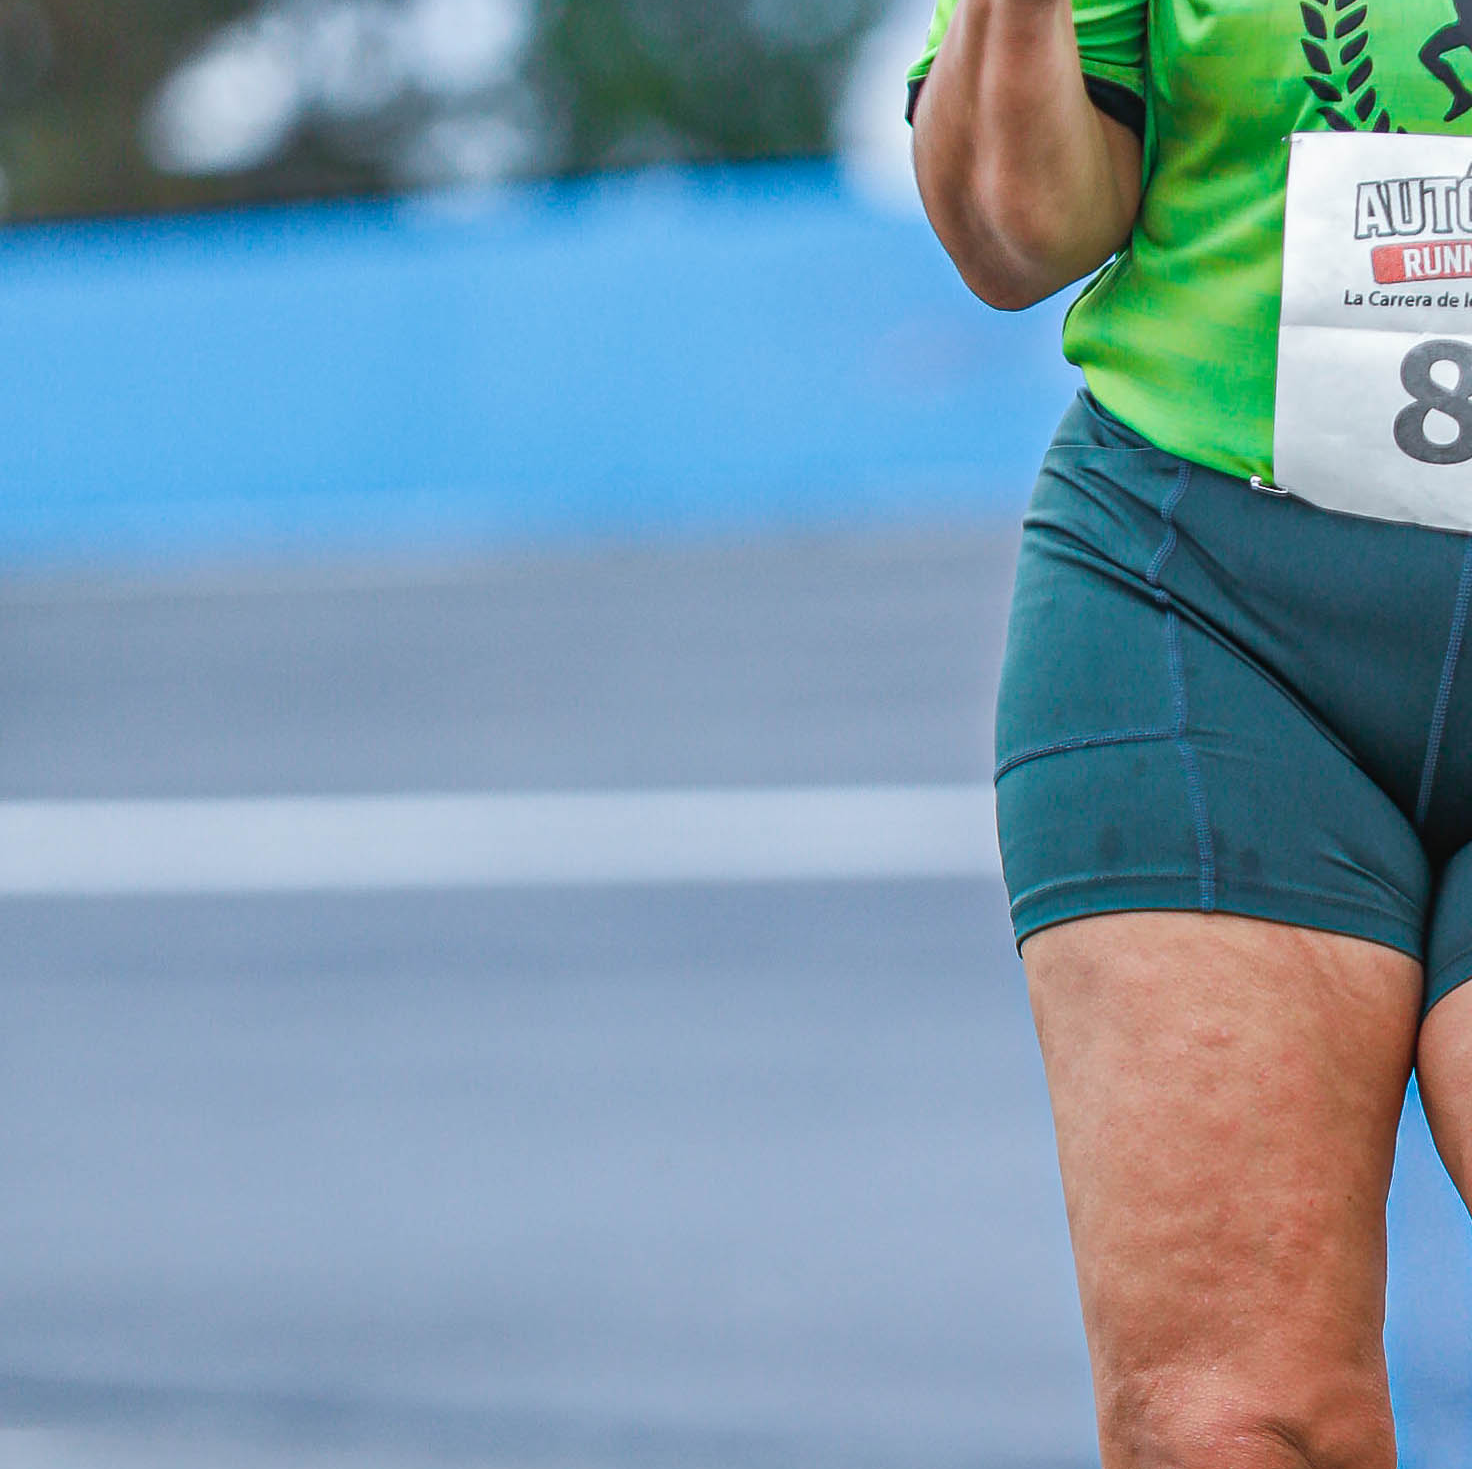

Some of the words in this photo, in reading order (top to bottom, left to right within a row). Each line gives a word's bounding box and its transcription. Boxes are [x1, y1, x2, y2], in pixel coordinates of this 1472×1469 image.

[1344, 290, 1363, 306] La
[1368, 290, 1432, 308] Carrera
[1437, 291, 1460, 308] de
